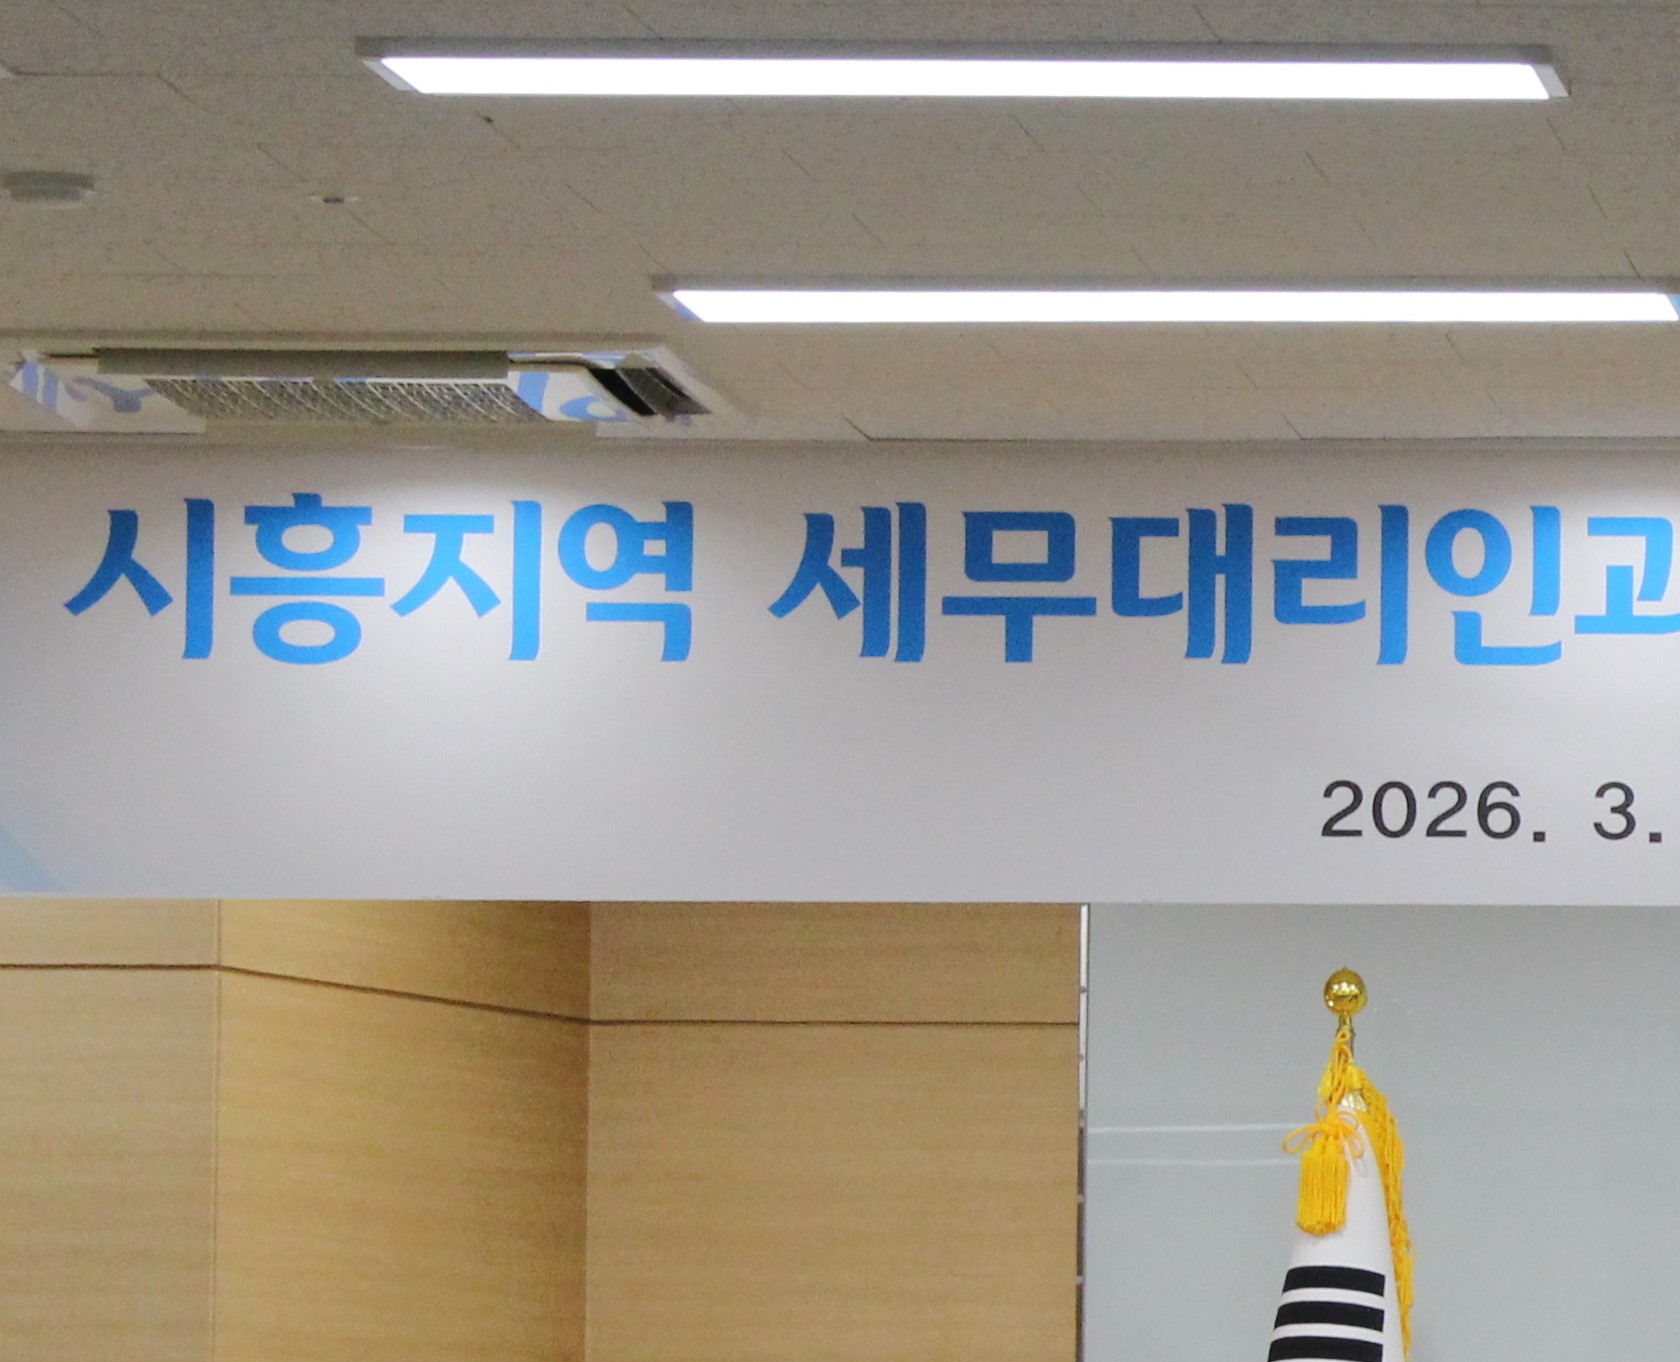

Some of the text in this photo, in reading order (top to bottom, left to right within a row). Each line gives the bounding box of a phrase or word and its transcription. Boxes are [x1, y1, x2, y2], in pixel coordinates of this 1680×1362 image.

[64, 491, 695, 666] 시흥지역
[1321, 779, 1546, 843] 2026.
[1593, 781, 1663, 844] 3.
